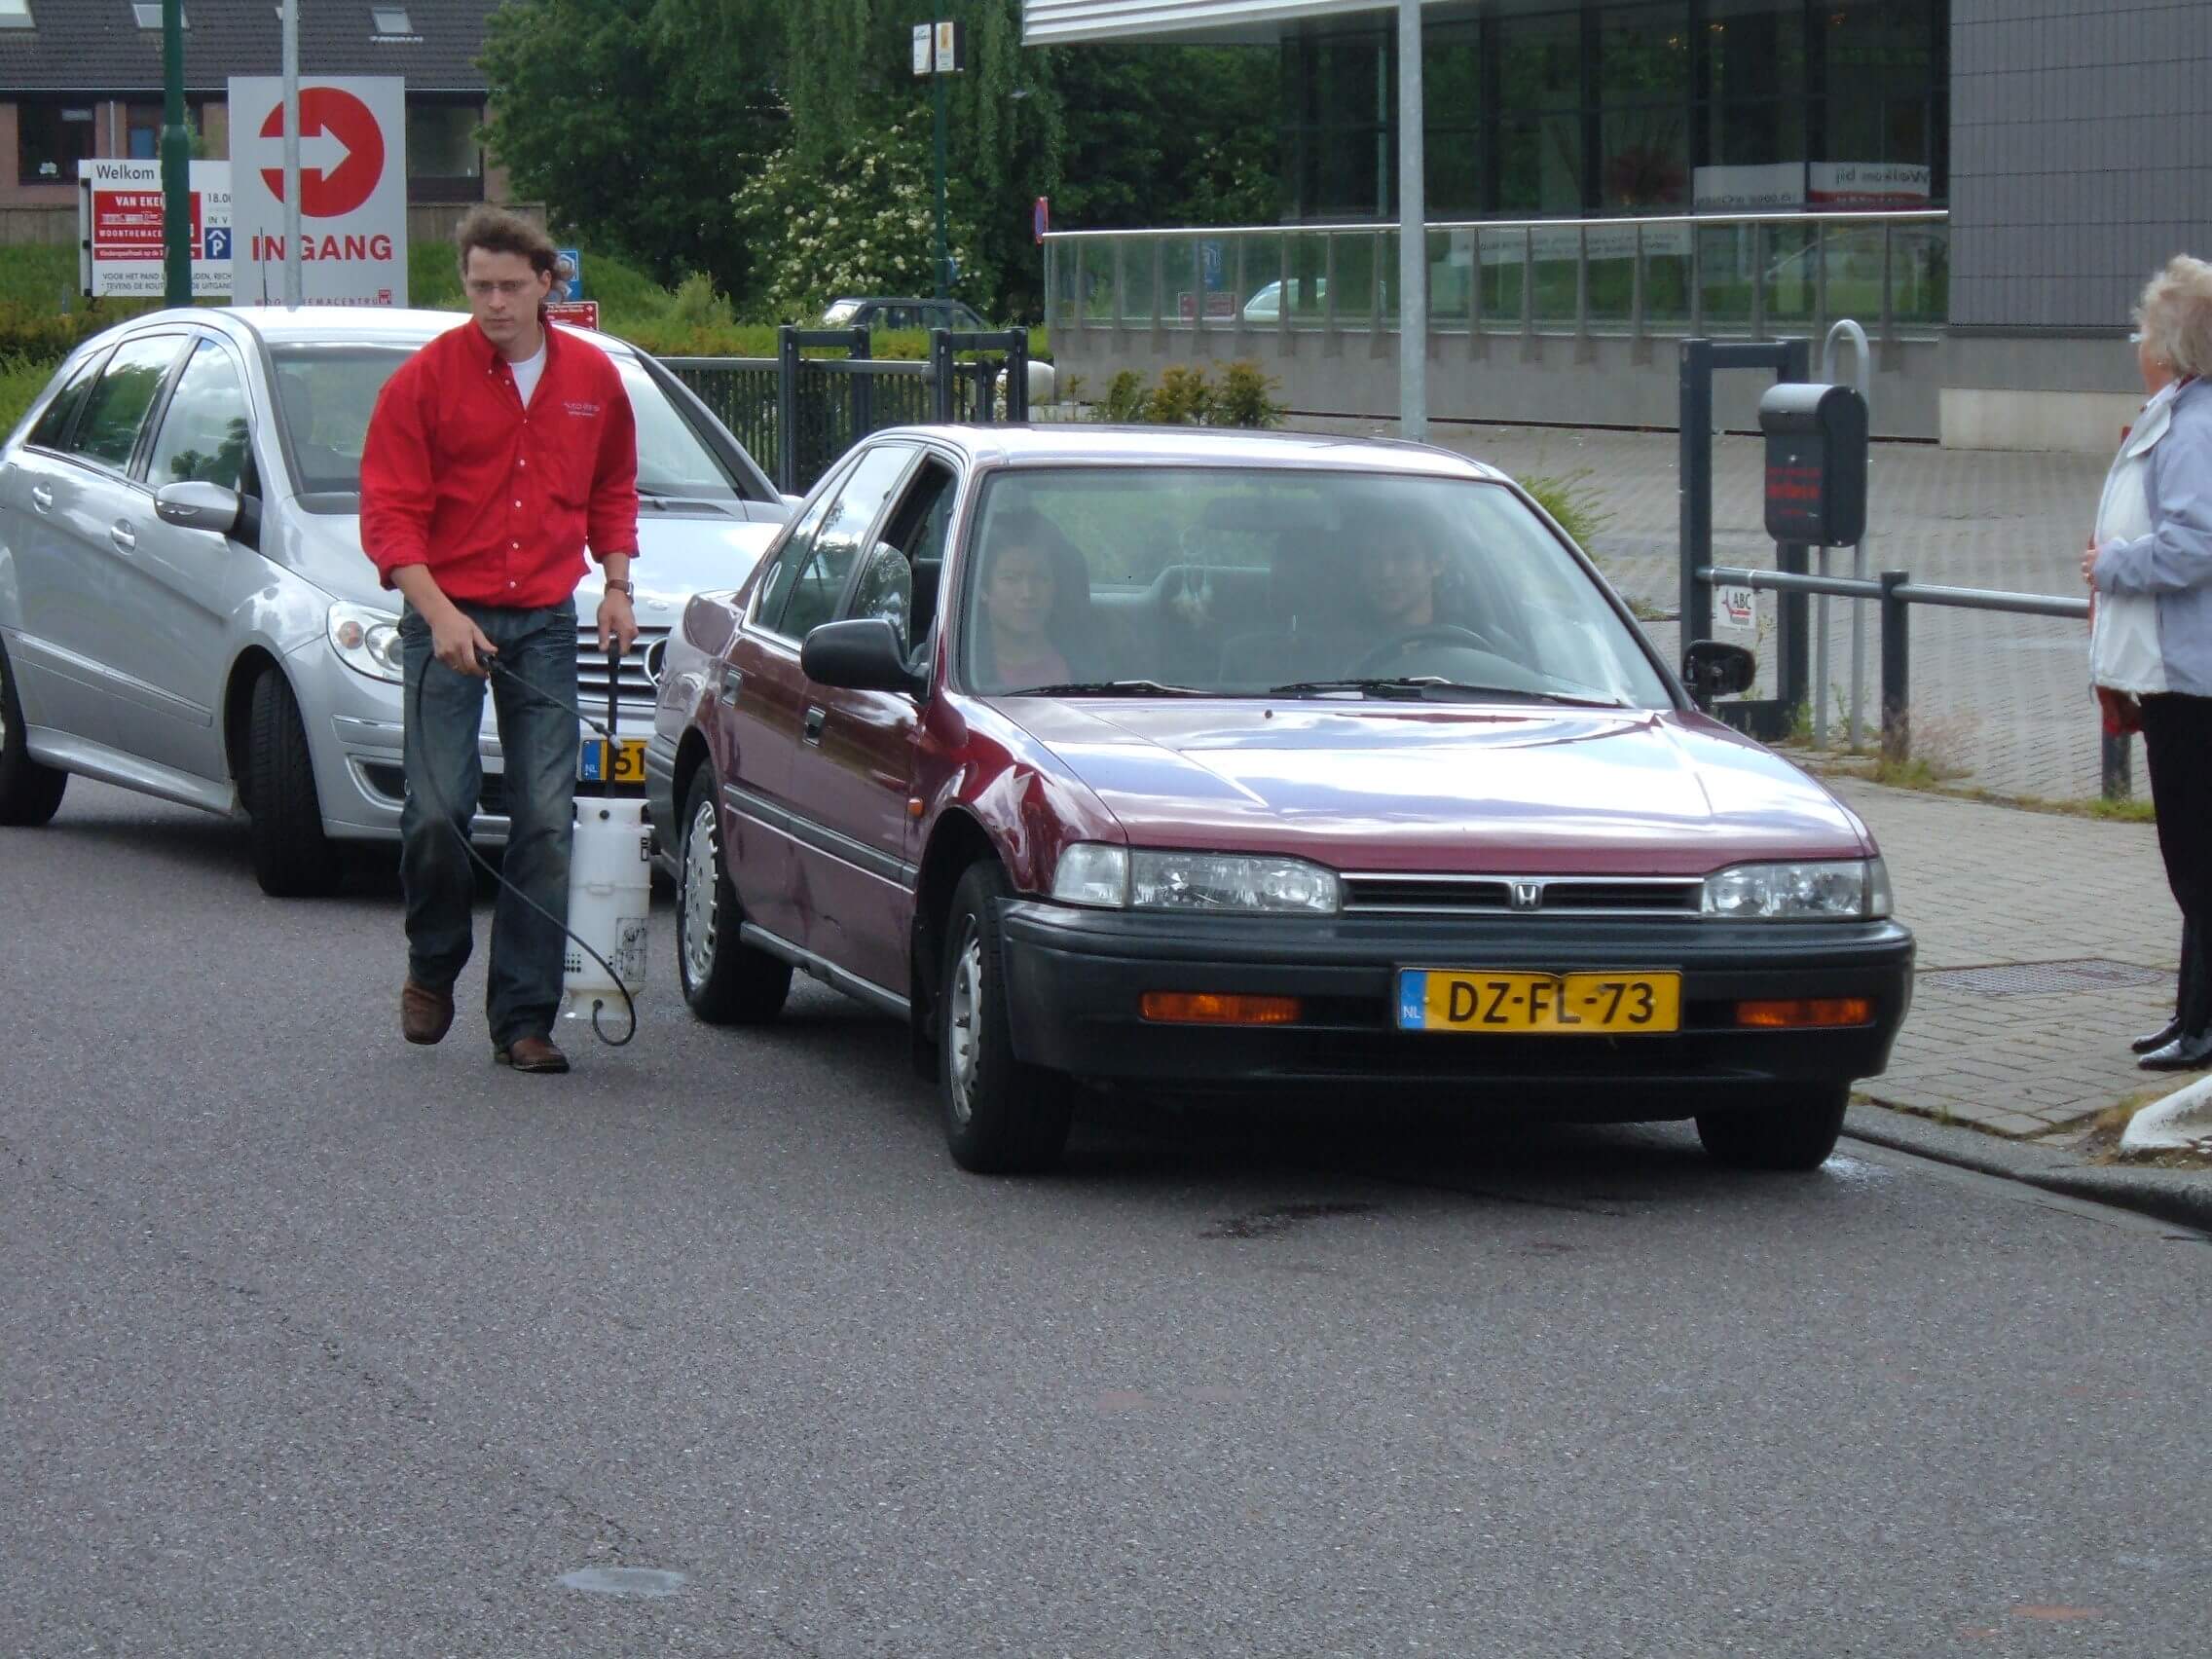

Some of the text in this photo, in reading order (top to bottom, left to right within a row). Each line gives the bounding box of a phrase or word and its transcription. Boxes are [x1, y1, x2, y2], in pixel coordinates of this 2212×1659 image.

[96, 164, 155, 180] Welkom
[115, 196, 164, 207] VAN EKE
[99, 229, 164, 238] WOONTHEMACE
[213, 240, 224, 256] P
[252, 234, 392, 261] INGANG
[1733, 592, 1752, 609] ABC
[1448, 980, 1654, 1024] DZ-FL-73
[1401, 1005, 1421, 1019] NL
